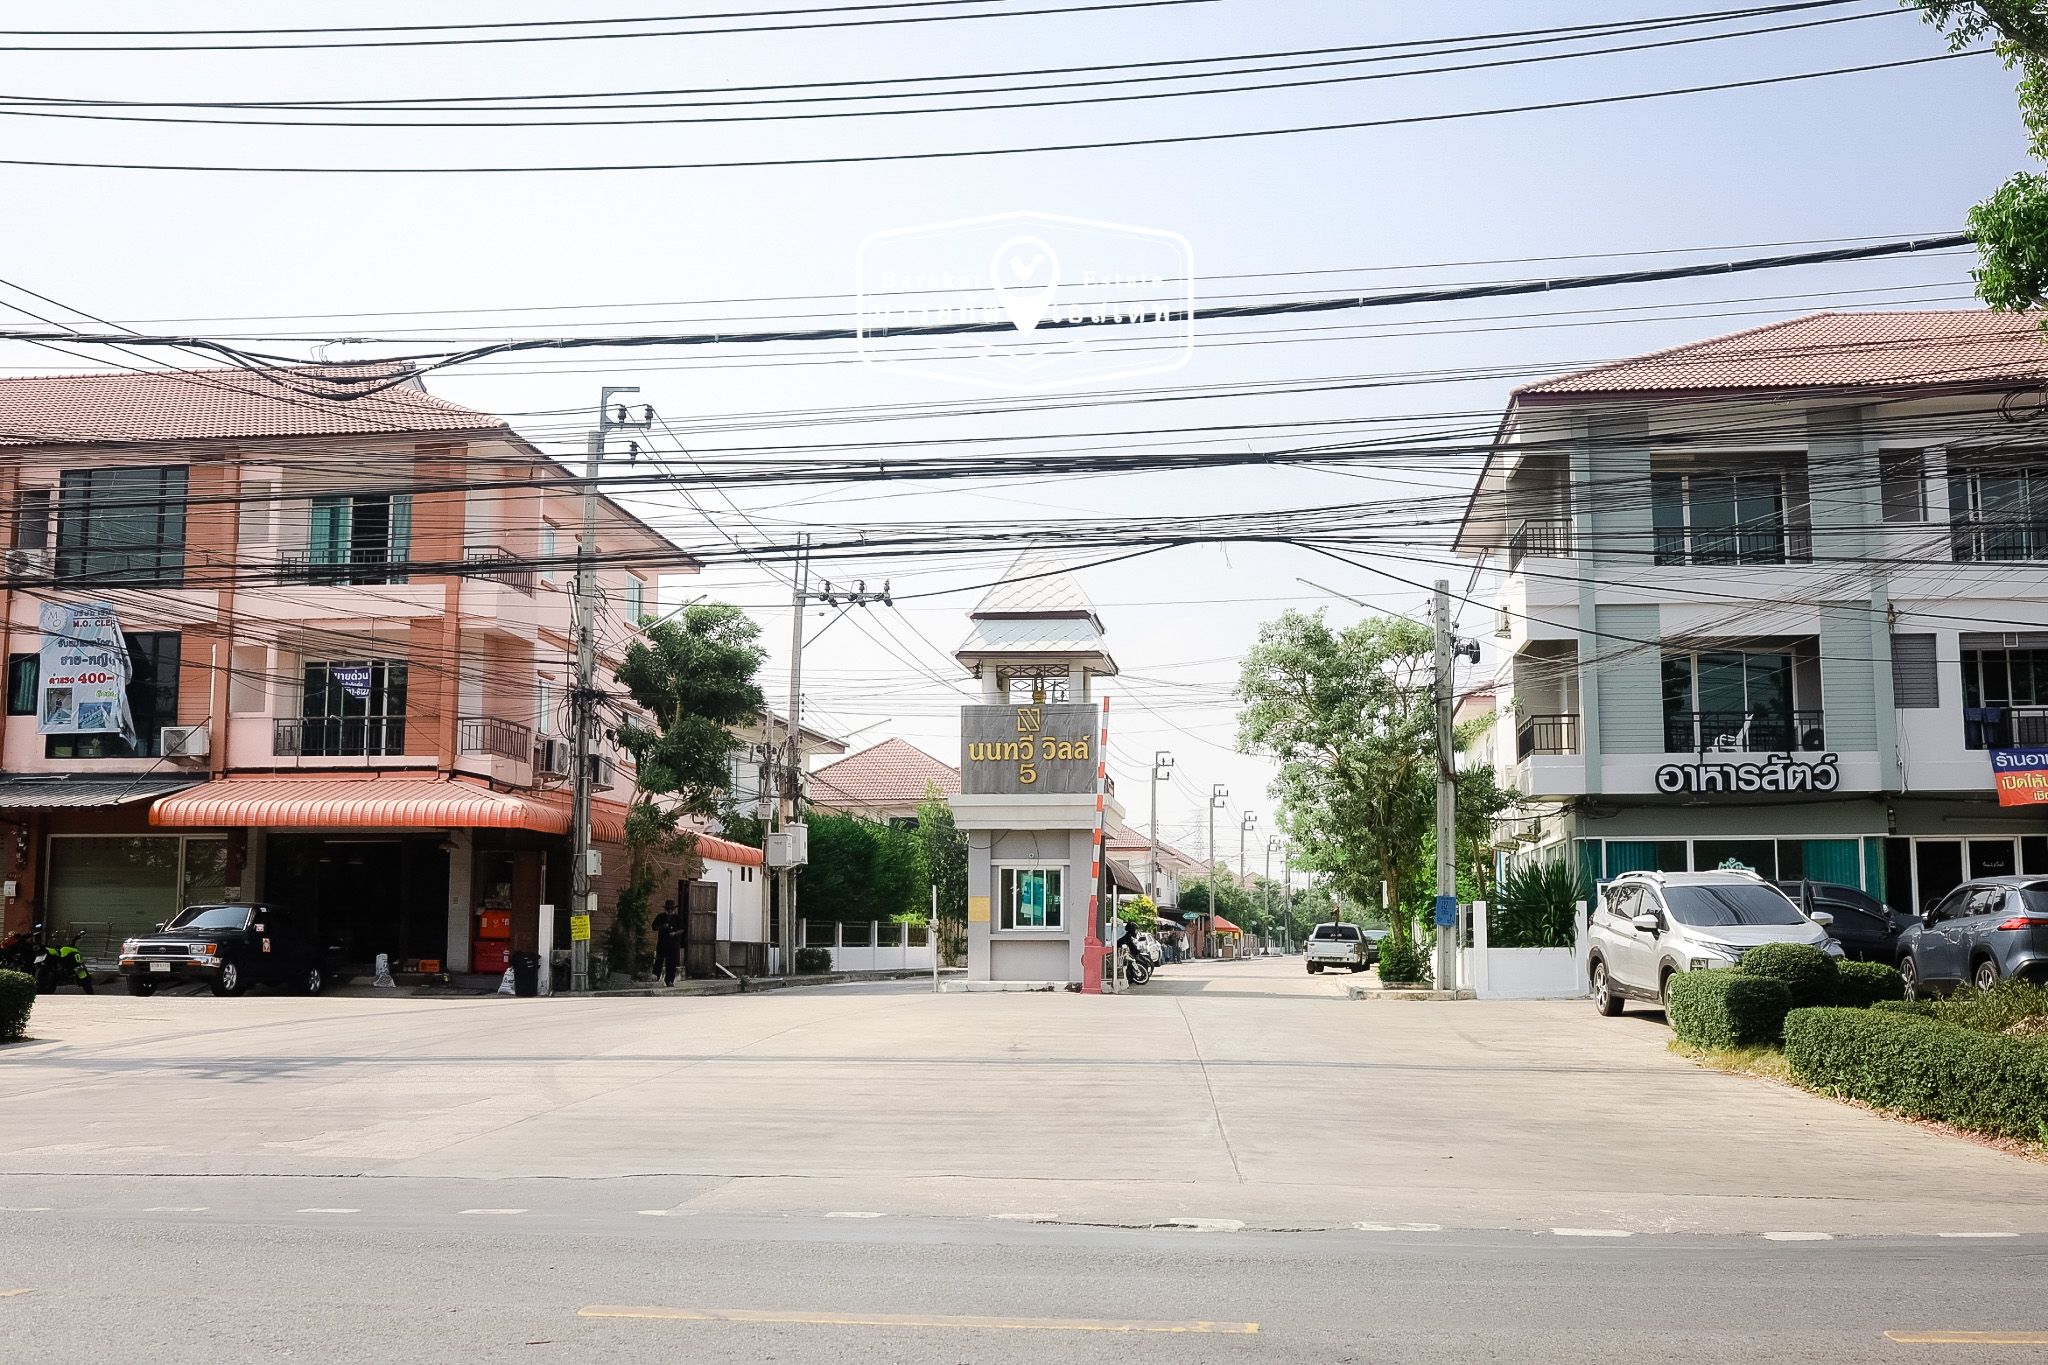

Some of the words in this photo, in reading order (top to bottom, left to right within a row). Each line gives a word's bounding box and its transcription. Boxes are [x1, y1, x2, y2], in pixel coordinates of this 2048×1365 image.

[968, 735, 1034, 760] นนทวี
[1041, 735, 1092, 760] วิลล์
[1020, 763, 1037, 784] 5
[1656, 753, 1839, 793] อาหารสัตว์
